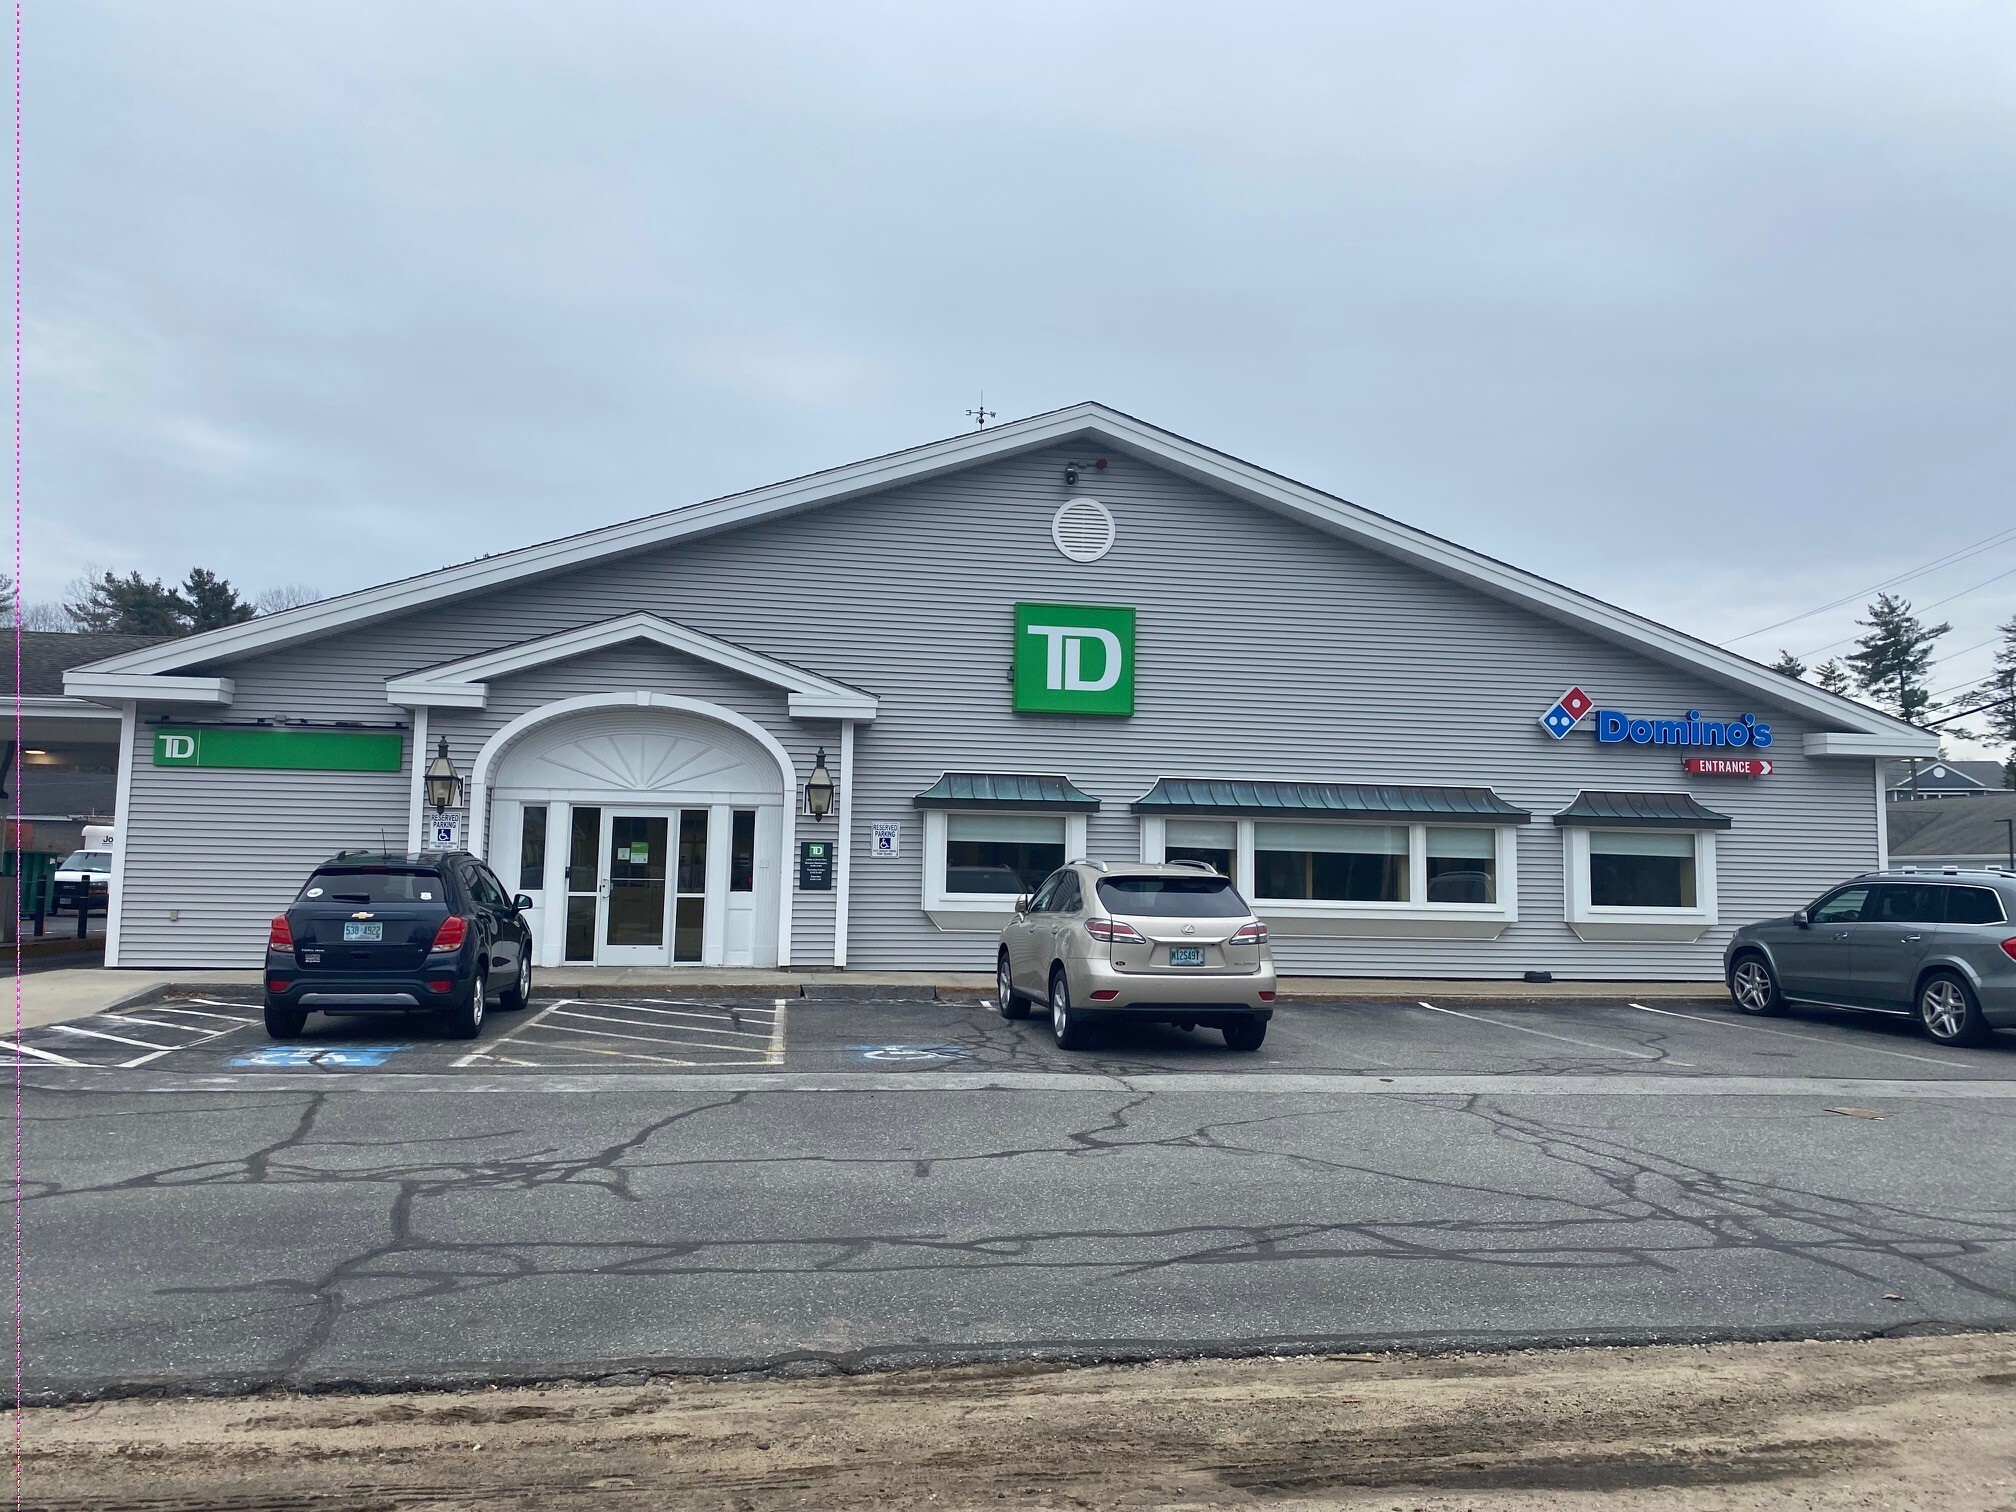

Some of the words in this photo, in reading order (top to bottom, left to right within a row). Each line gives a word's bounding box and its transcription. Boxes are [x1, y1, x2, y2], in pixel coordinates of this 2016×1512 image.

[1027, 625, 1122, 692] TD
[1595, 709, 1774, 748] Domino's
[158, 734, 195, 759] TD
[1699, 760, 1751, 774] ENTRANCE
[874, 830, 896, 838] PARKING
[810, 846, 823, 855] TD
[345, 925, 360, 935] 538
